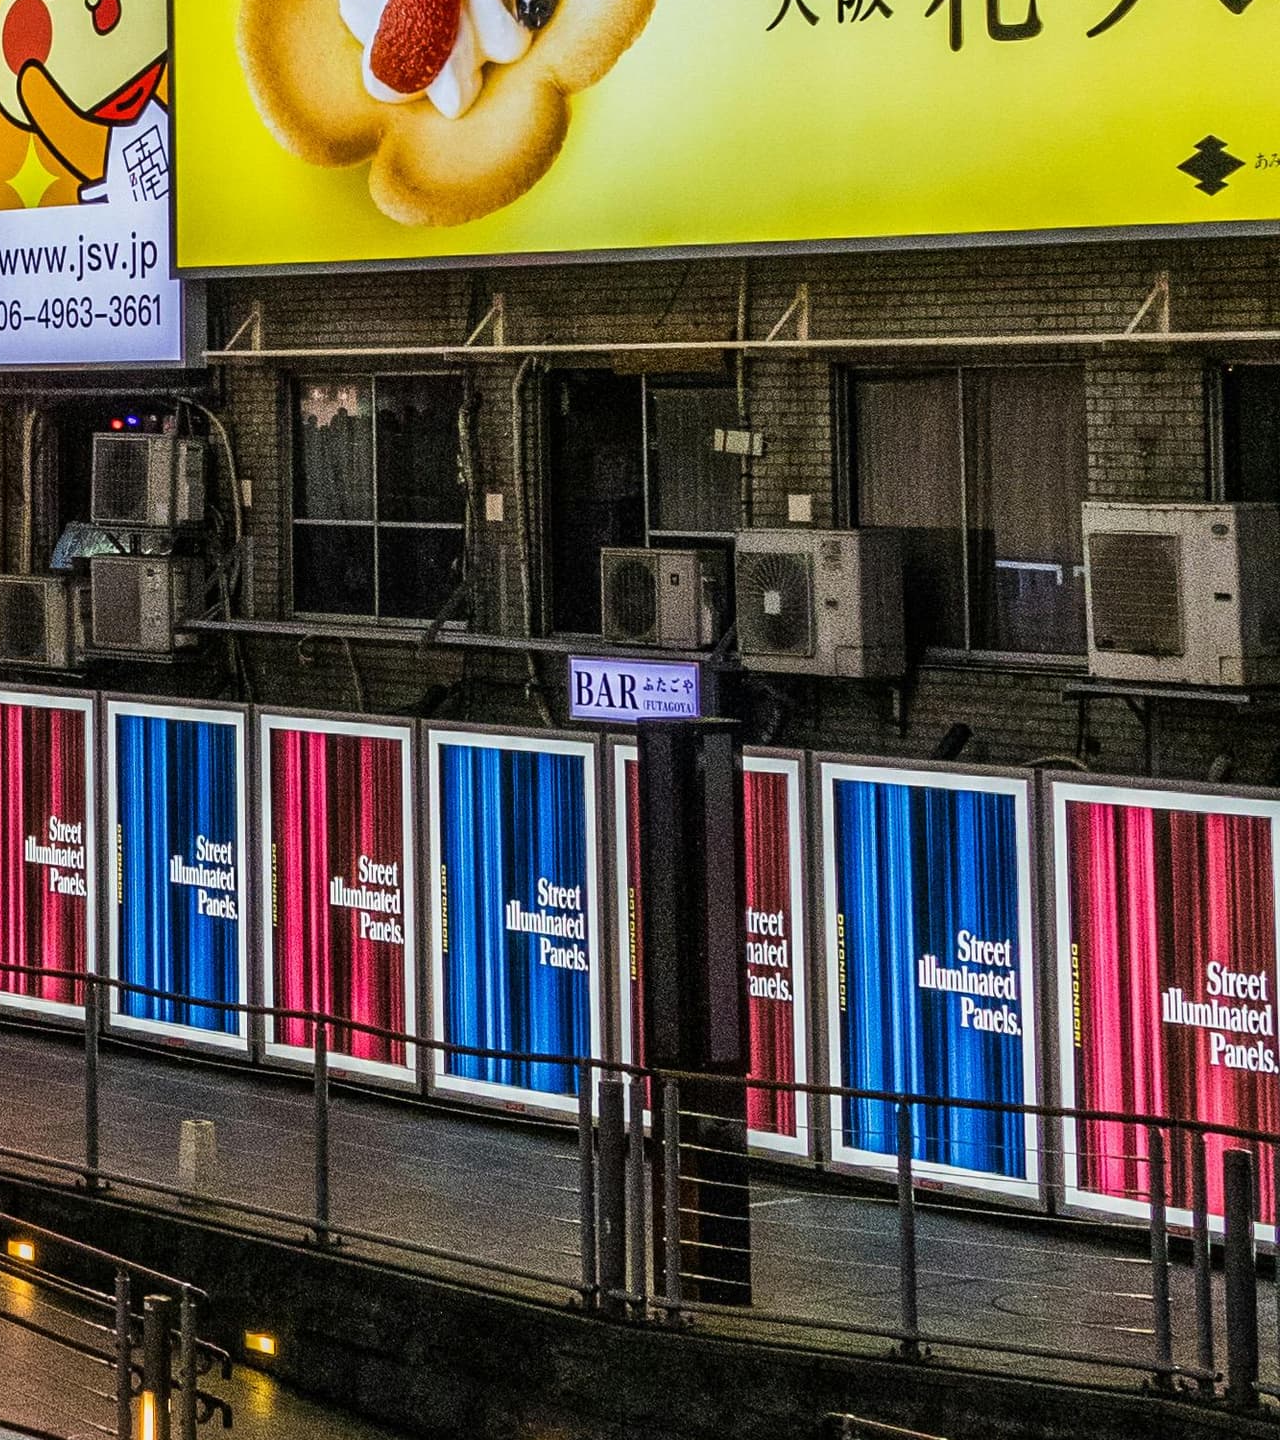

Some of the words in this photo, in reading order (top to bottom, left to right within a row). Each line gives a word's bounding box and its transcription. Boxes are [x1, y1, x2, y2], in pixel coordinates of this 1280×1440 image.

[575, 672, 639, 711] BAR
[643, 675, 695, 695] ふたごや
[643, 698, 695, 716] (FUTAGOYA)
[49, 814, 82, 846] Street
[195, 833, 232, 867] Street
[49, 866, 87, 897] Panels.
[358, 854, 399, 887] Street
[197, 889, 238, 921] Panels.
[440, 864, 449, 954] DOTONBORI
[537, 876, 582, 911] Street
[359, 910, 405, 945] Panels.
[628, 887, 637, 981] DOTONBORI
[538, 936, 590, 972] Panels.
[837, 913, 848, 1012] DOTONBORI
[957, 929, 1013, 968] Street
[1071, 942, 1083, 1048] DOTONBORI
[1207, 961, 1268, 1002] Street
[960, 997, 1023, 1036] Panels.
[1210, 1030, 1279, 1073] Panels.
